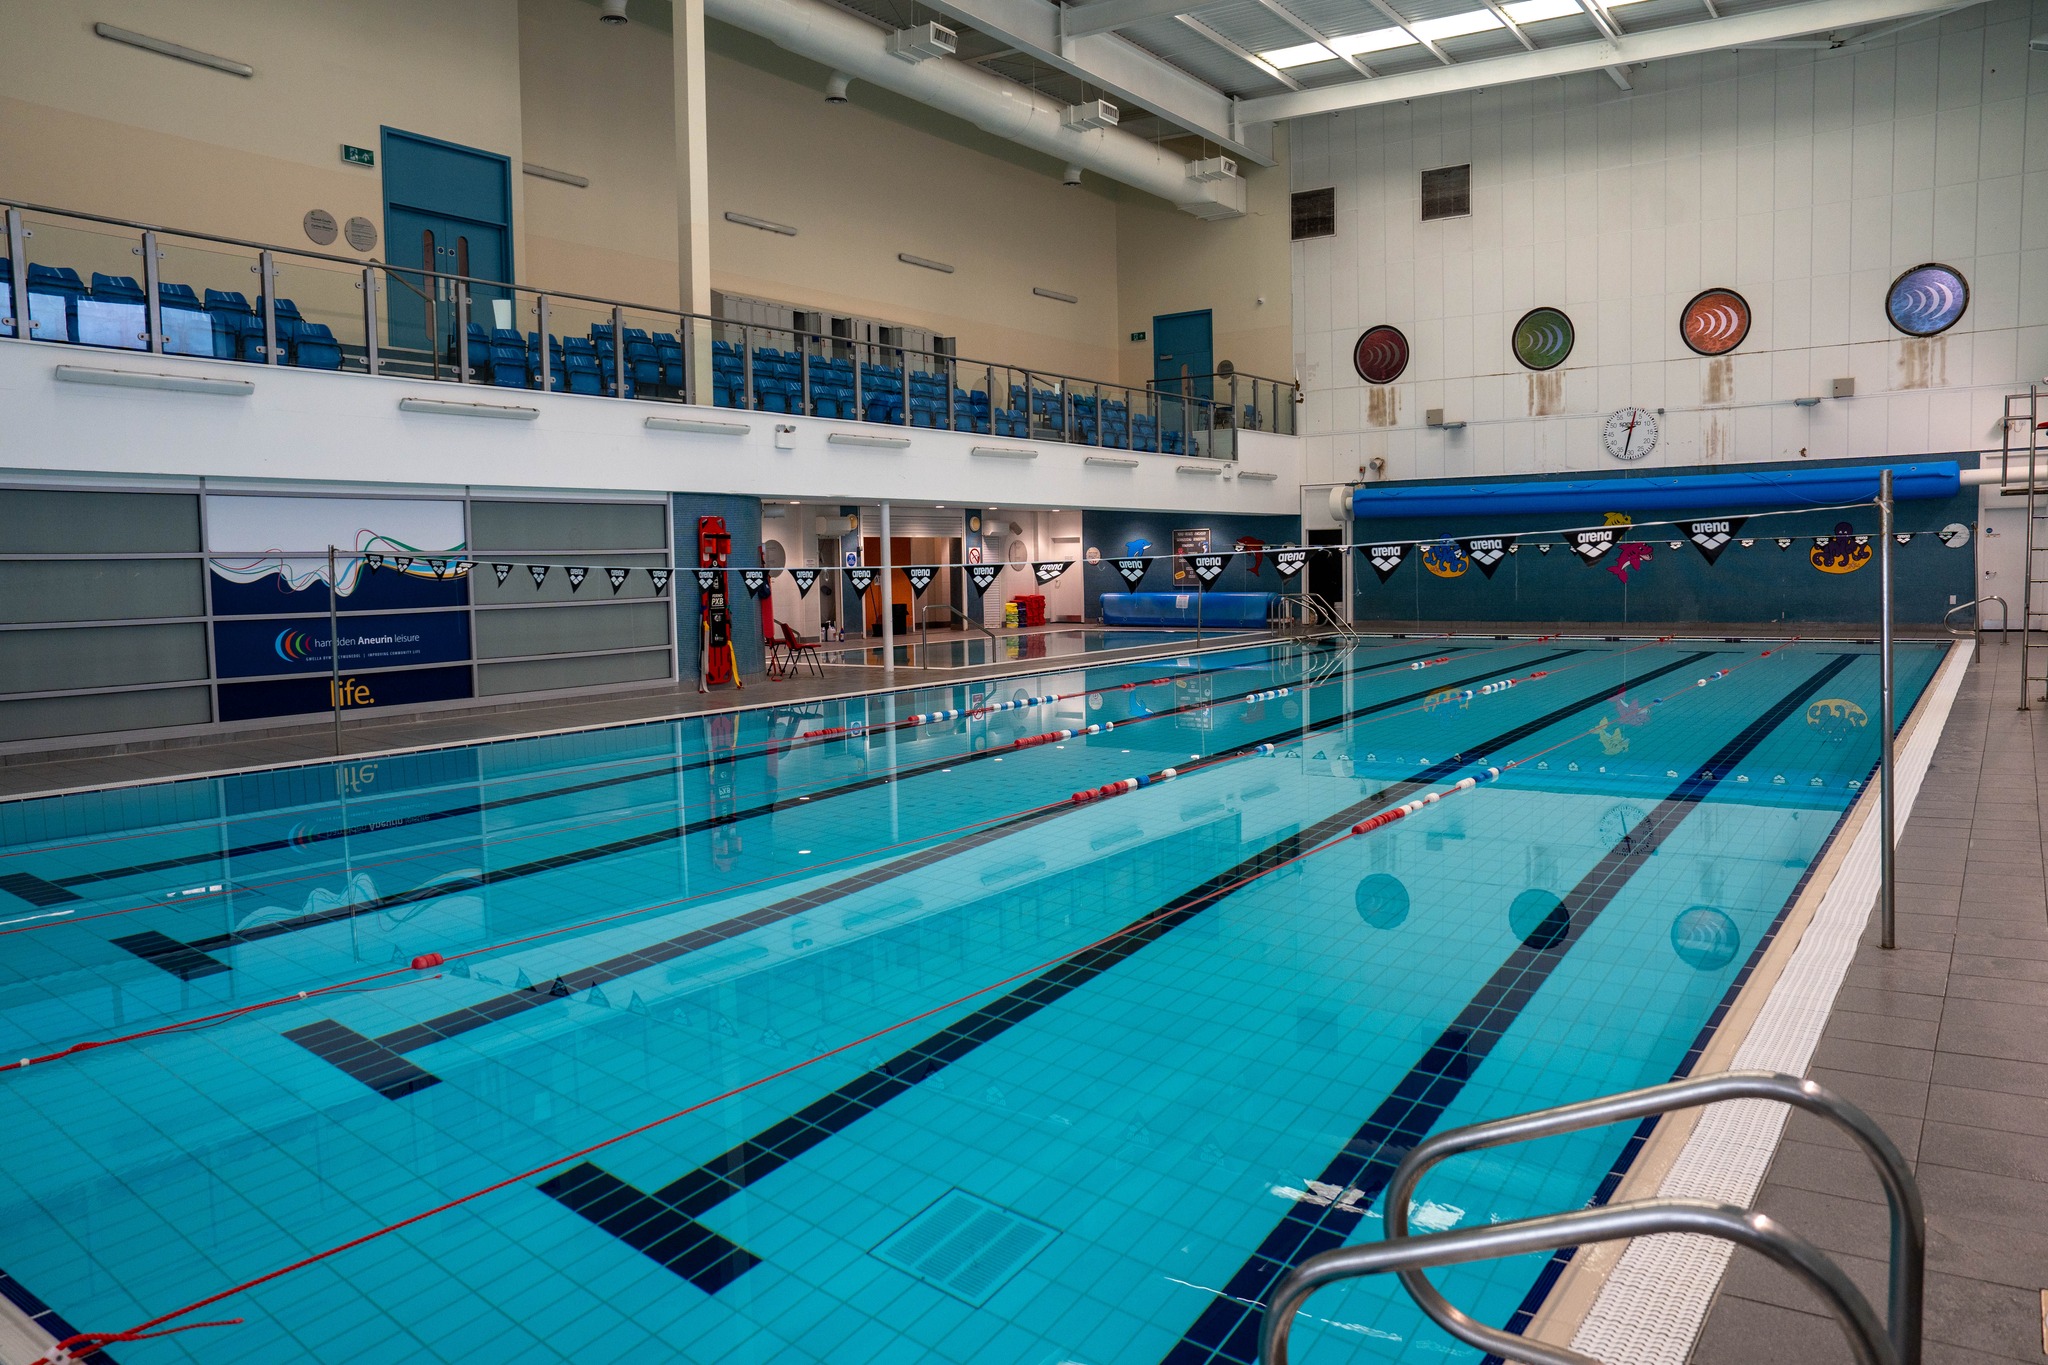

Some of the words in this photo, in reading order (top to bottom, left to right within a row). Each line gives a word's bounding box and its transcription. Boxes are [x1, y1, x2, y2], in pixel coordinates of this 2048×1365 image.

[1692, 521, 1729, 534] arena
[1577, 531, 1612, 543] arena
[1470, 539, 1502, 550] arena
[1371, 546, 1400, 556] arena
[1196, 557, 1221, 566] arena
[1278, 552, 1306, 562] arena
[1119, 560, 1143, 569] arena
[911, 569, 930, 577] arena
[974, 567, 994, 575] arena
[358, 635, 392, 645] Aneurin
[394, 634, 420, 642] leisure
[330, 678, 375, 707] life.
